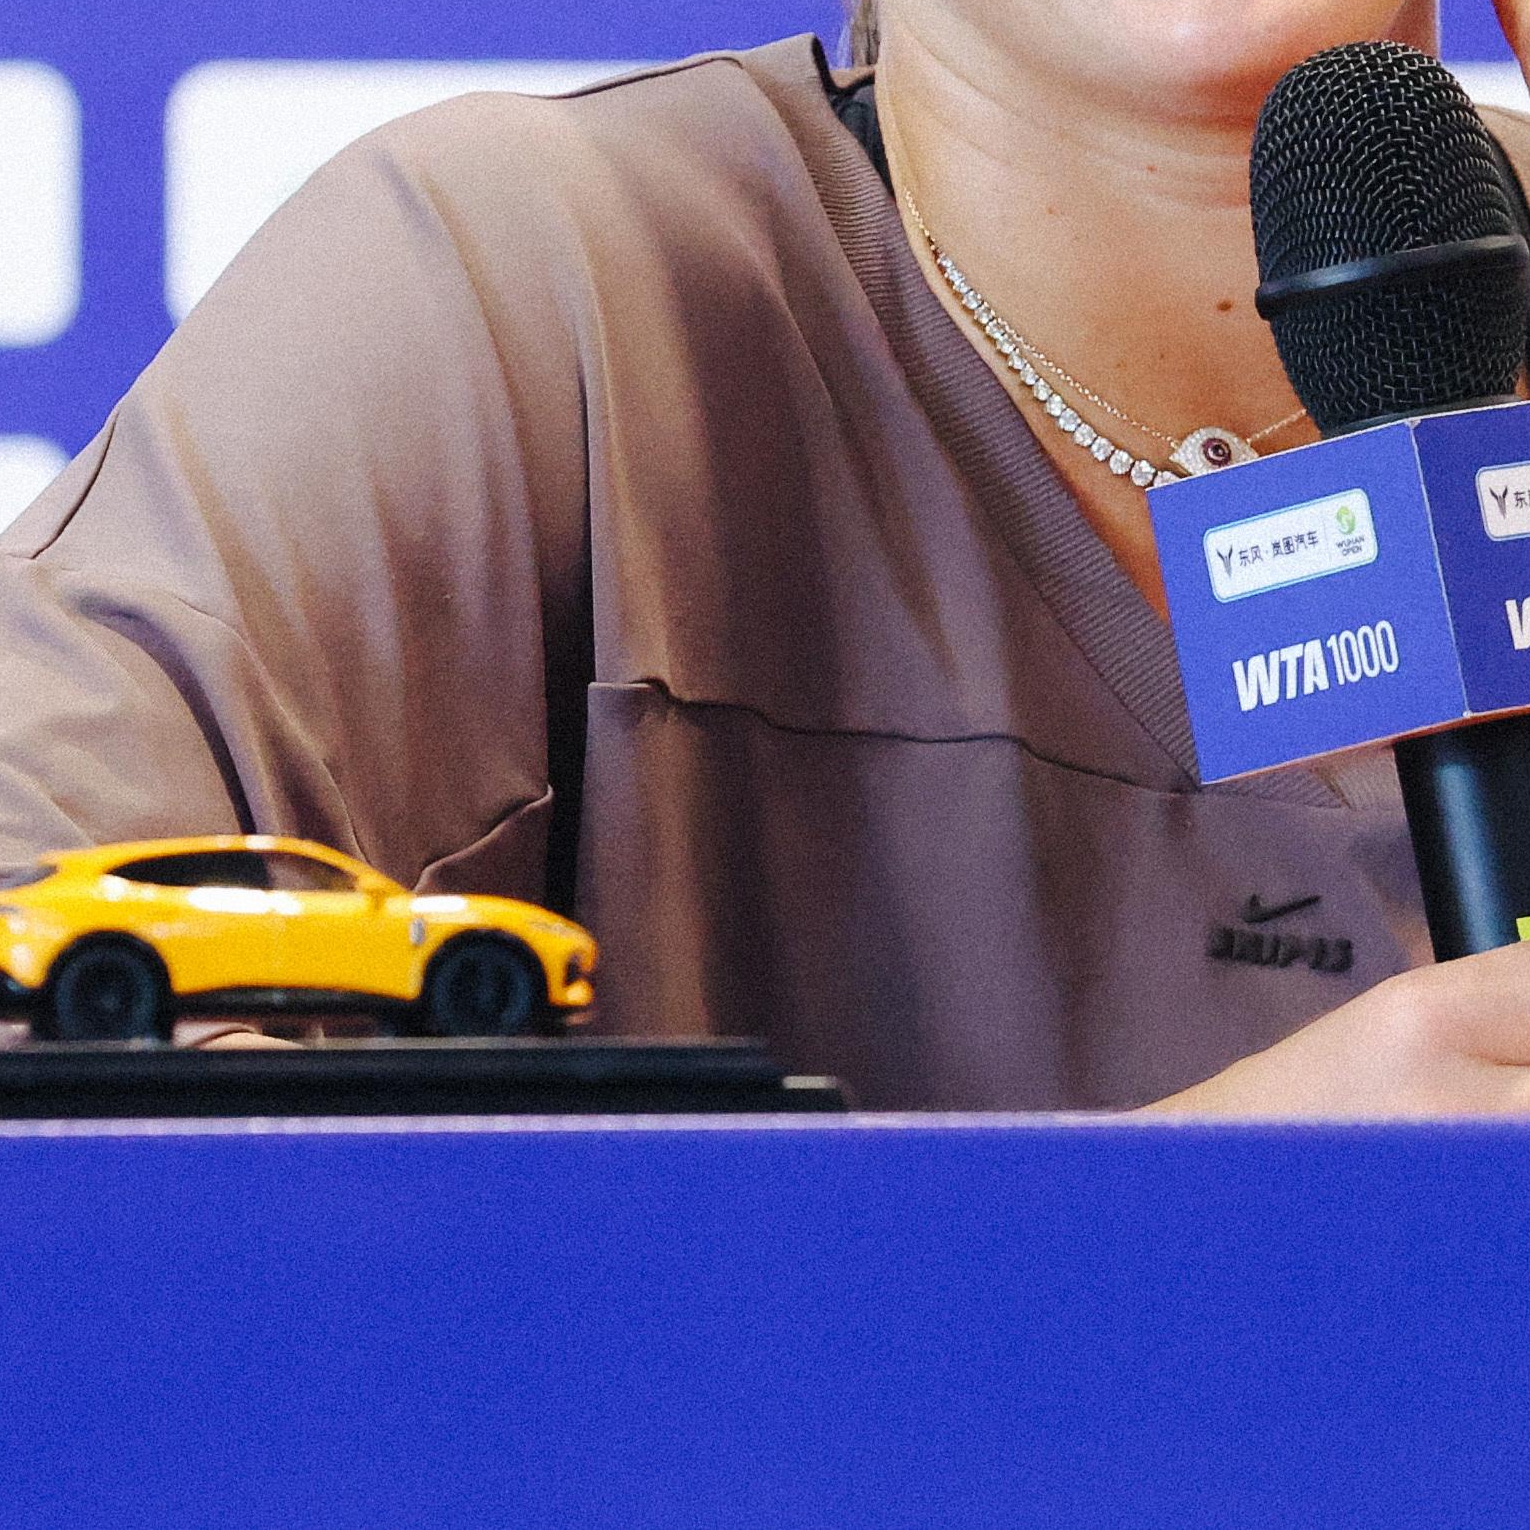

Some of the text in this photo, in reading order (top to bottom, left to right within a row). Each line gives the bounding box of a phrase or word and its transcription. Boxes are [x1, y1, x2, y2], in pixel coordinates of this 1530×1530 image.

[1335, 535, 1366, 549] WUHAN
[1341, 545, 1363, 557] OPEN
[1232, 620, 1399, 712] WTA 1000
